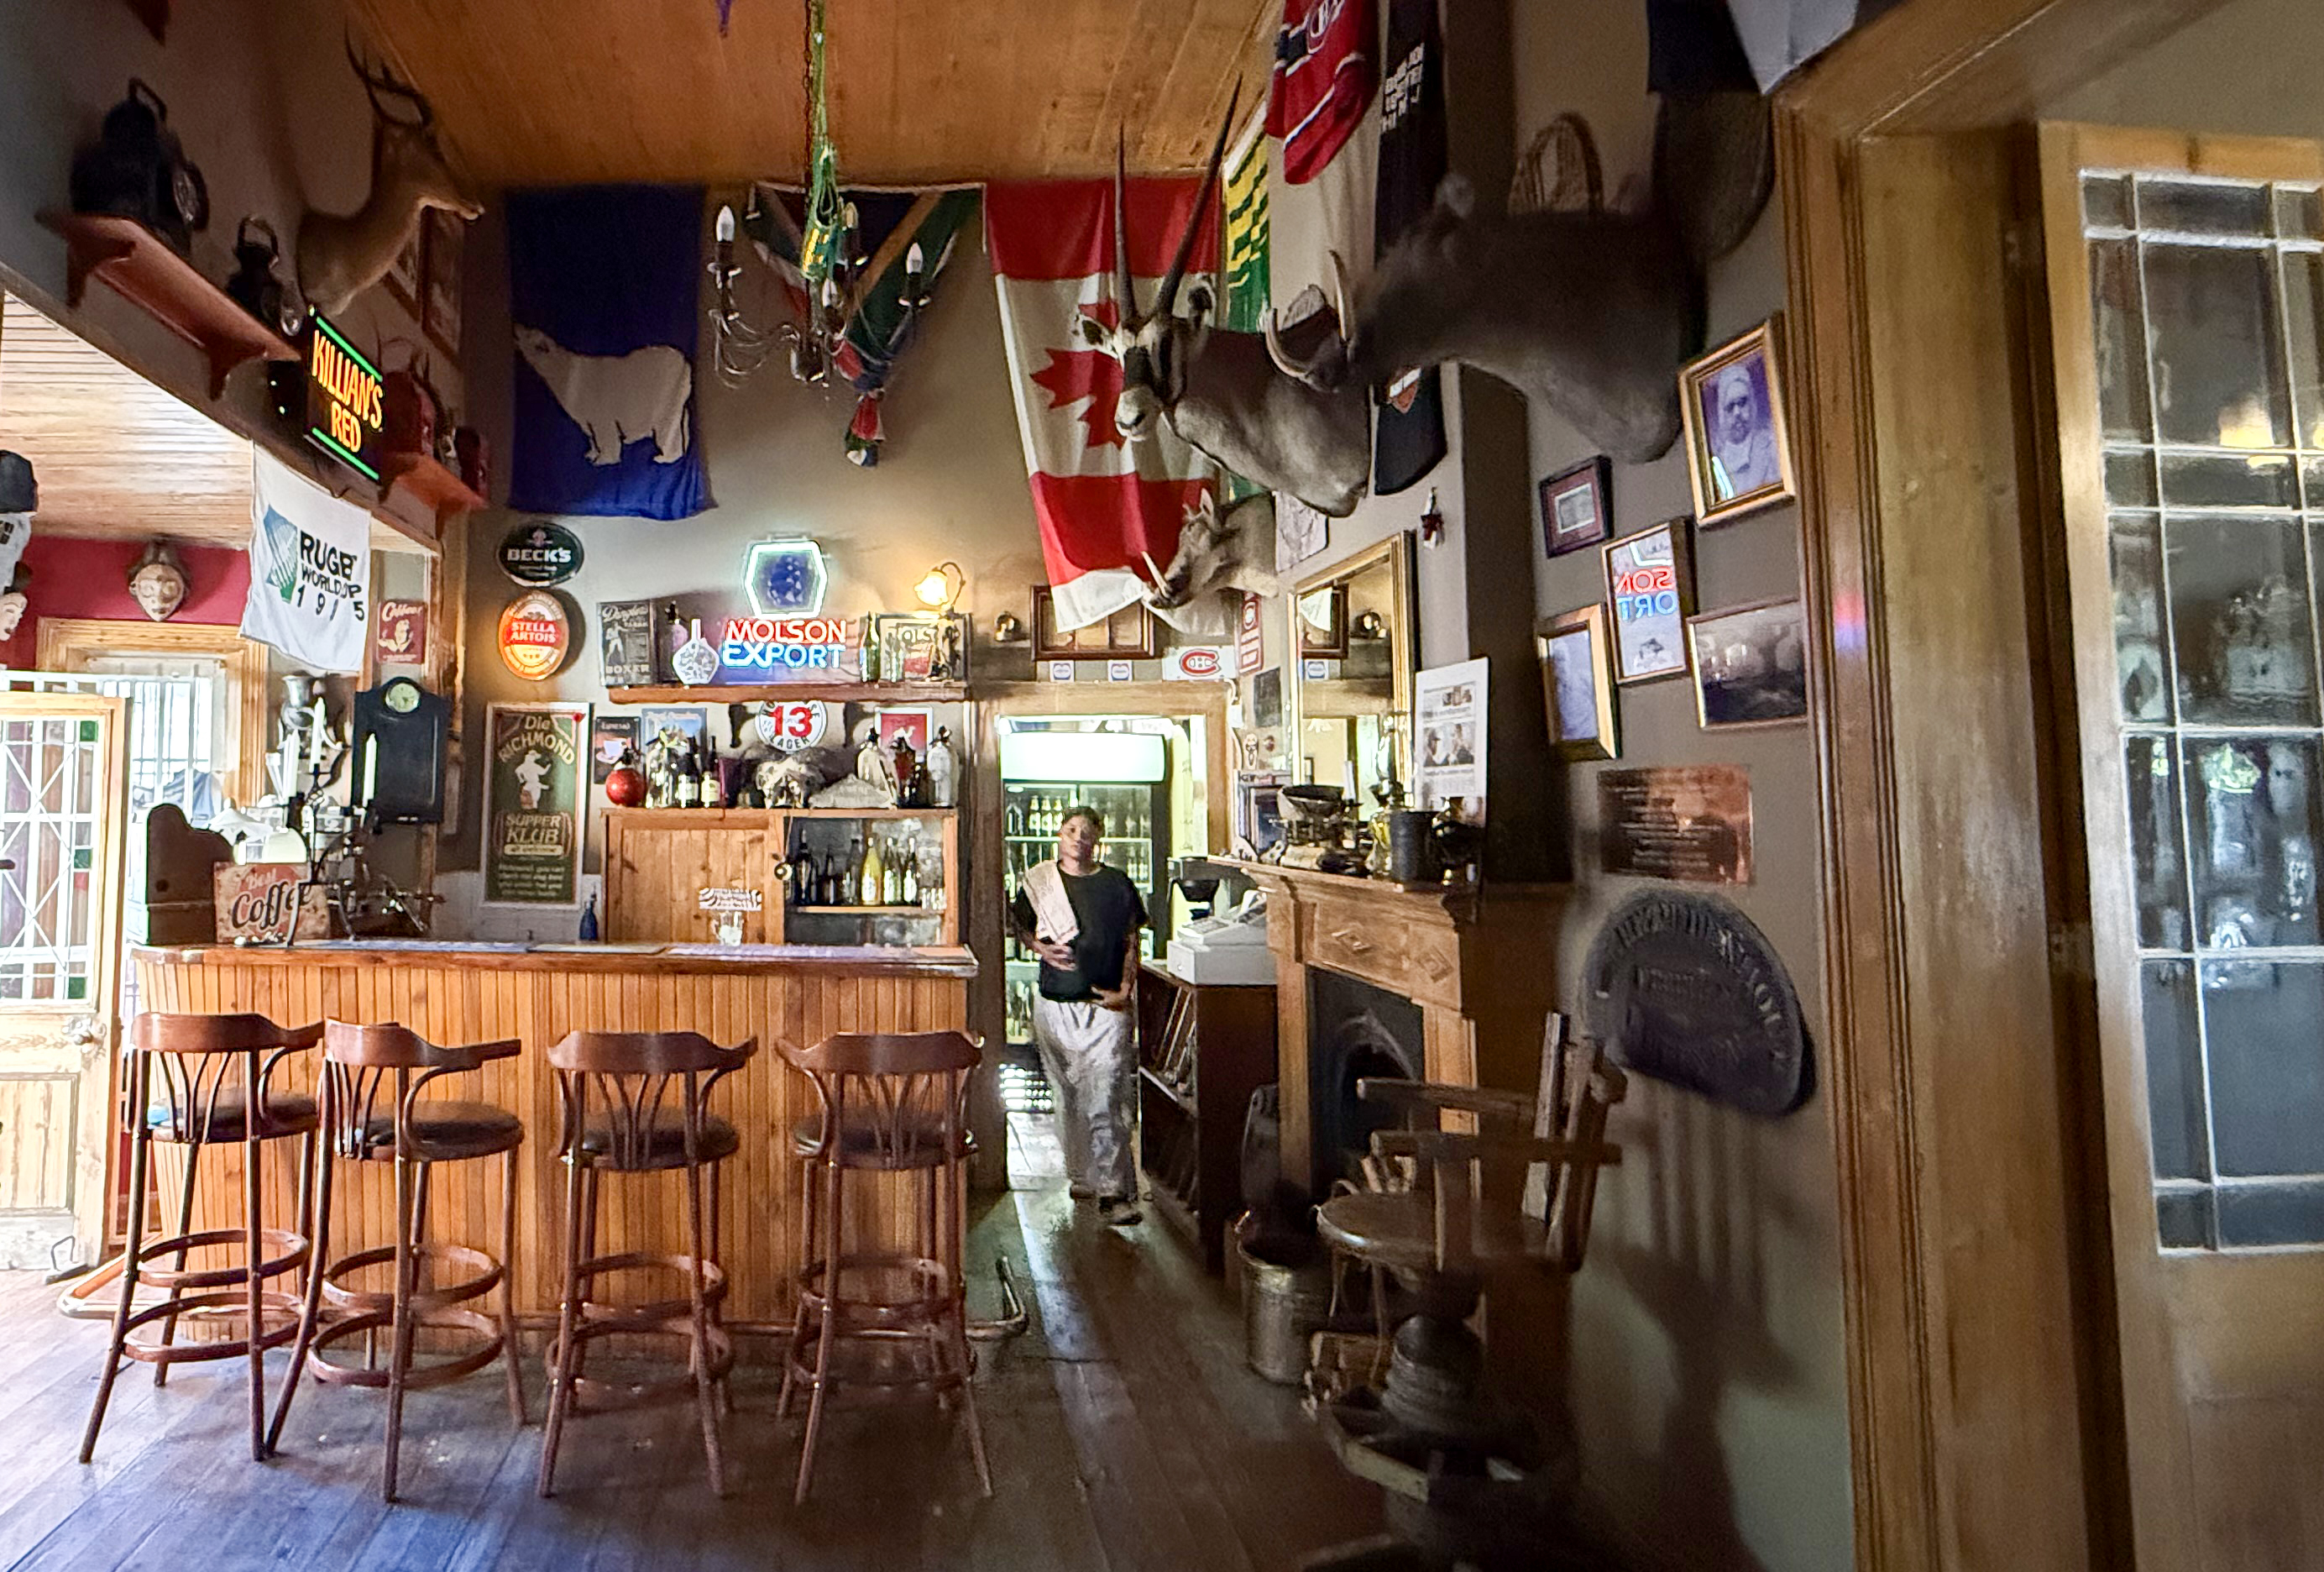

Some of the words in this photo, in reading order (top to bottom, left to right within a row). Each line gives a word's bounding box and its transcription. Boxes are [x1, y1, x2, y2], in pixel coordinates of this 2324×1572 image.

[311, 329, 384, 429] KILLIAN'S
[331, 400, 362, 453] RED
[300, 528, 357, 582] RUGB
[506, 548, 572, 563] BECK'S
[510, 621, 556, 633] STELLA
[510, 631, 557, 644] ARTOIS
[725, 619, 847, 644] MOLSON
[722, 641, 846, 668] EXPORT
[605, 664, 650, 674] BOXER
[525, 715, 551, 730] Die
[770, 705, 813, 737] 13
[498, 731, 575, 765] RICHMOND
[505, 815, 562, 828] SUPPER
[506, 827, 559, 844] KLUB
[232, 880, 312, 930] Coffee
